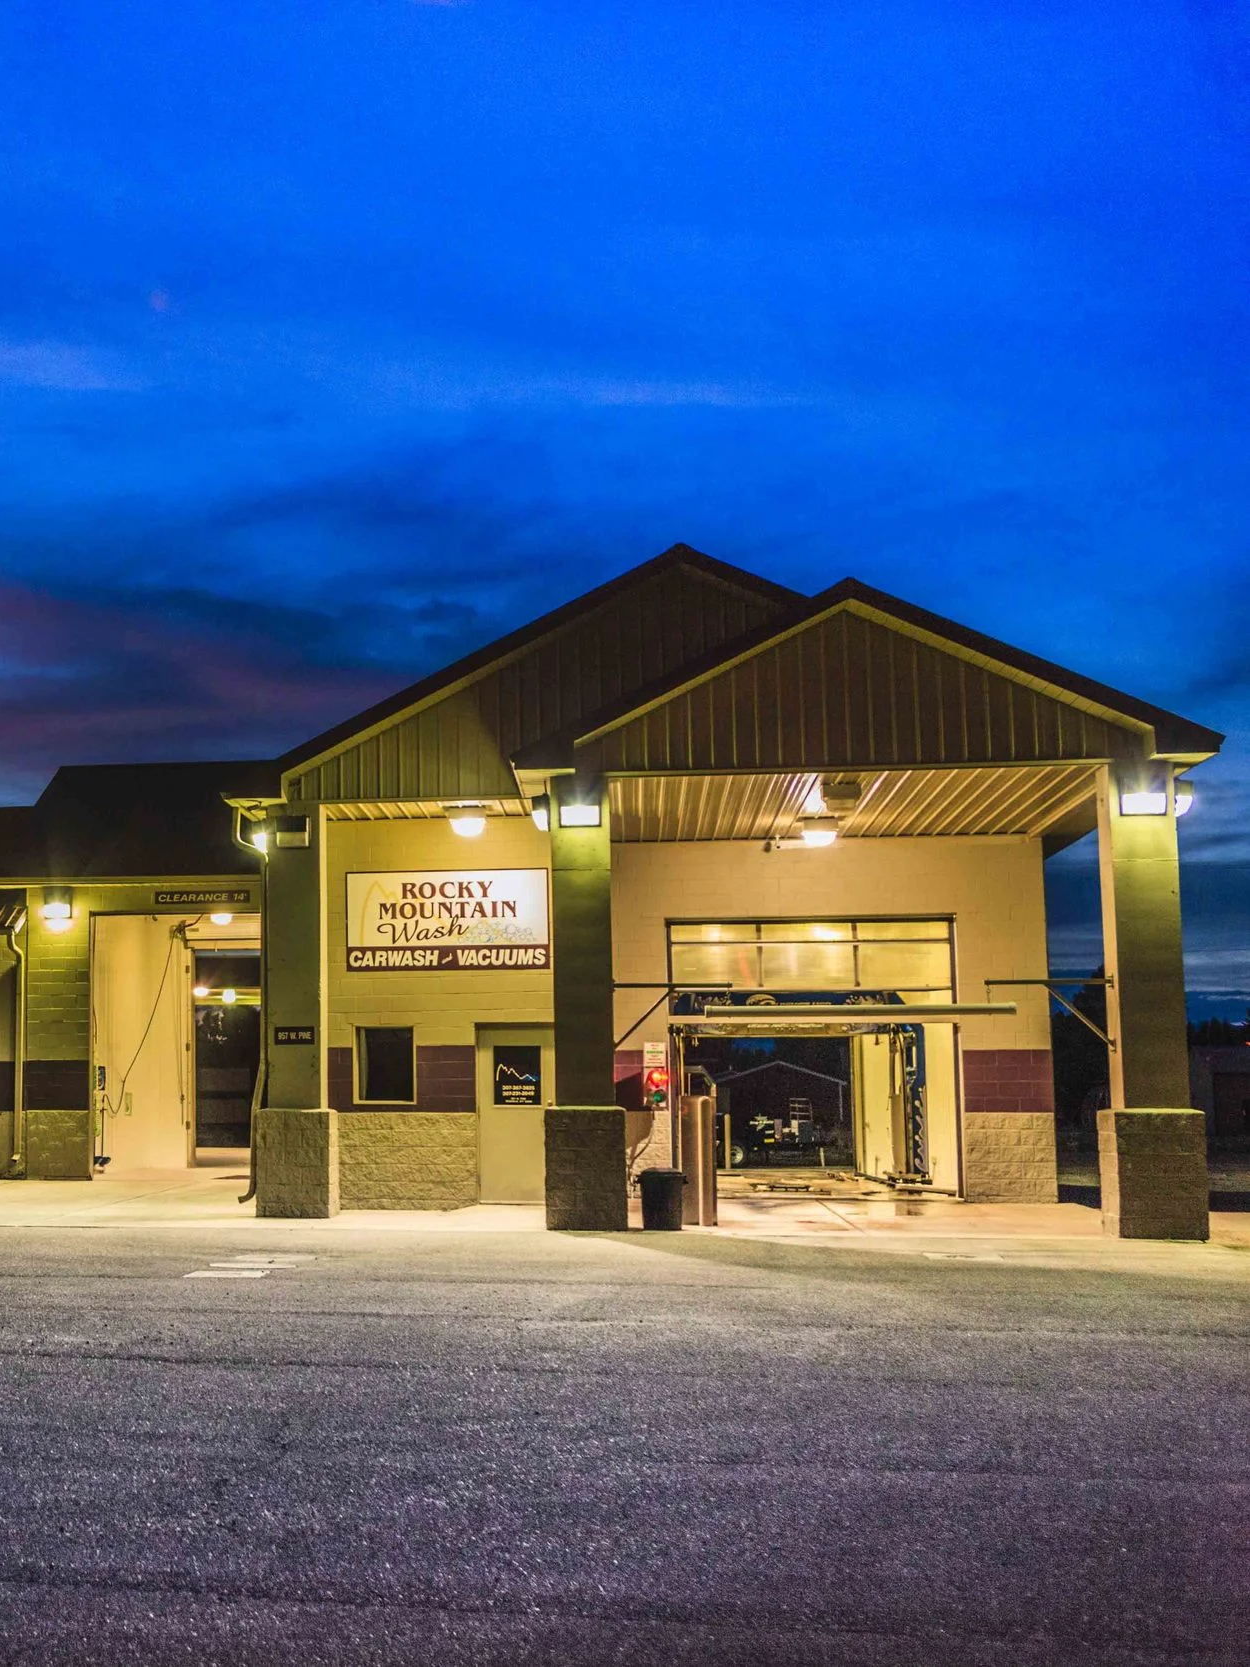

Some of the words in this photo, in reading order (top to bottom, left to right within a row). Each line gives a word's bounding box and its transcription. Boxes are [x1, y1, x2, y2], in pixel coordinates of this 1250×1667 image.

[158, 893, 228, 902] CLEARANCE
[401, 881, 493, 900] ROCKY
[379, 900, 517, 920] MOUNTAIN
[377, 914, 469, 945] Wash
[349, 949, 439, 967] CARWASH
[457, 948, 546, 966] VACUUMS
